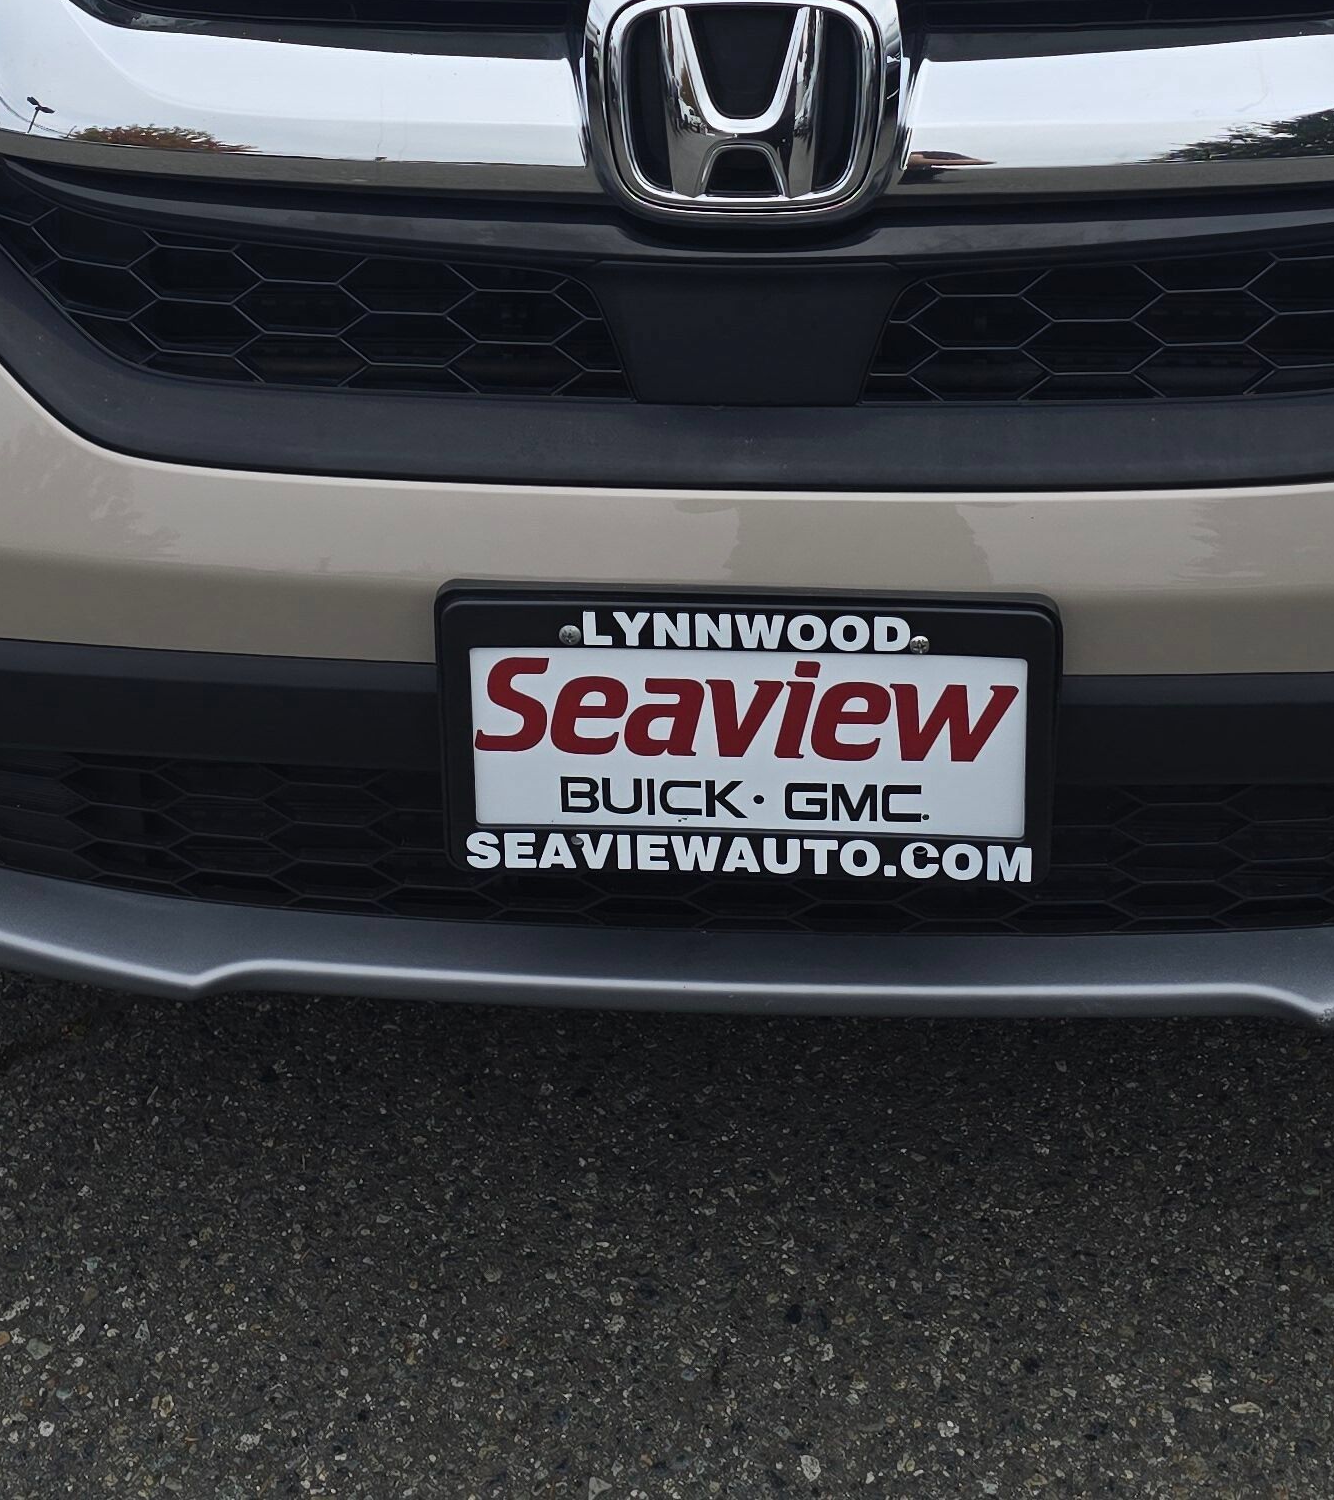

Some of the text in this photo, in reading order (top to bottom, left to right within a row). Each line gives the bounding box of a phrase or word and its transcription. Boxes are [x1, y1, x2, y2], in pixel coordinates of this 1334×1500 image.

[582, 610, 911, 652] LYNNWOOD
[474, 656, 1020, 762] Seaview
[560, 776, 922, 822] BUICK GMC
[465, 831, 1033, 883] SEAVIEWAUTO.COM
